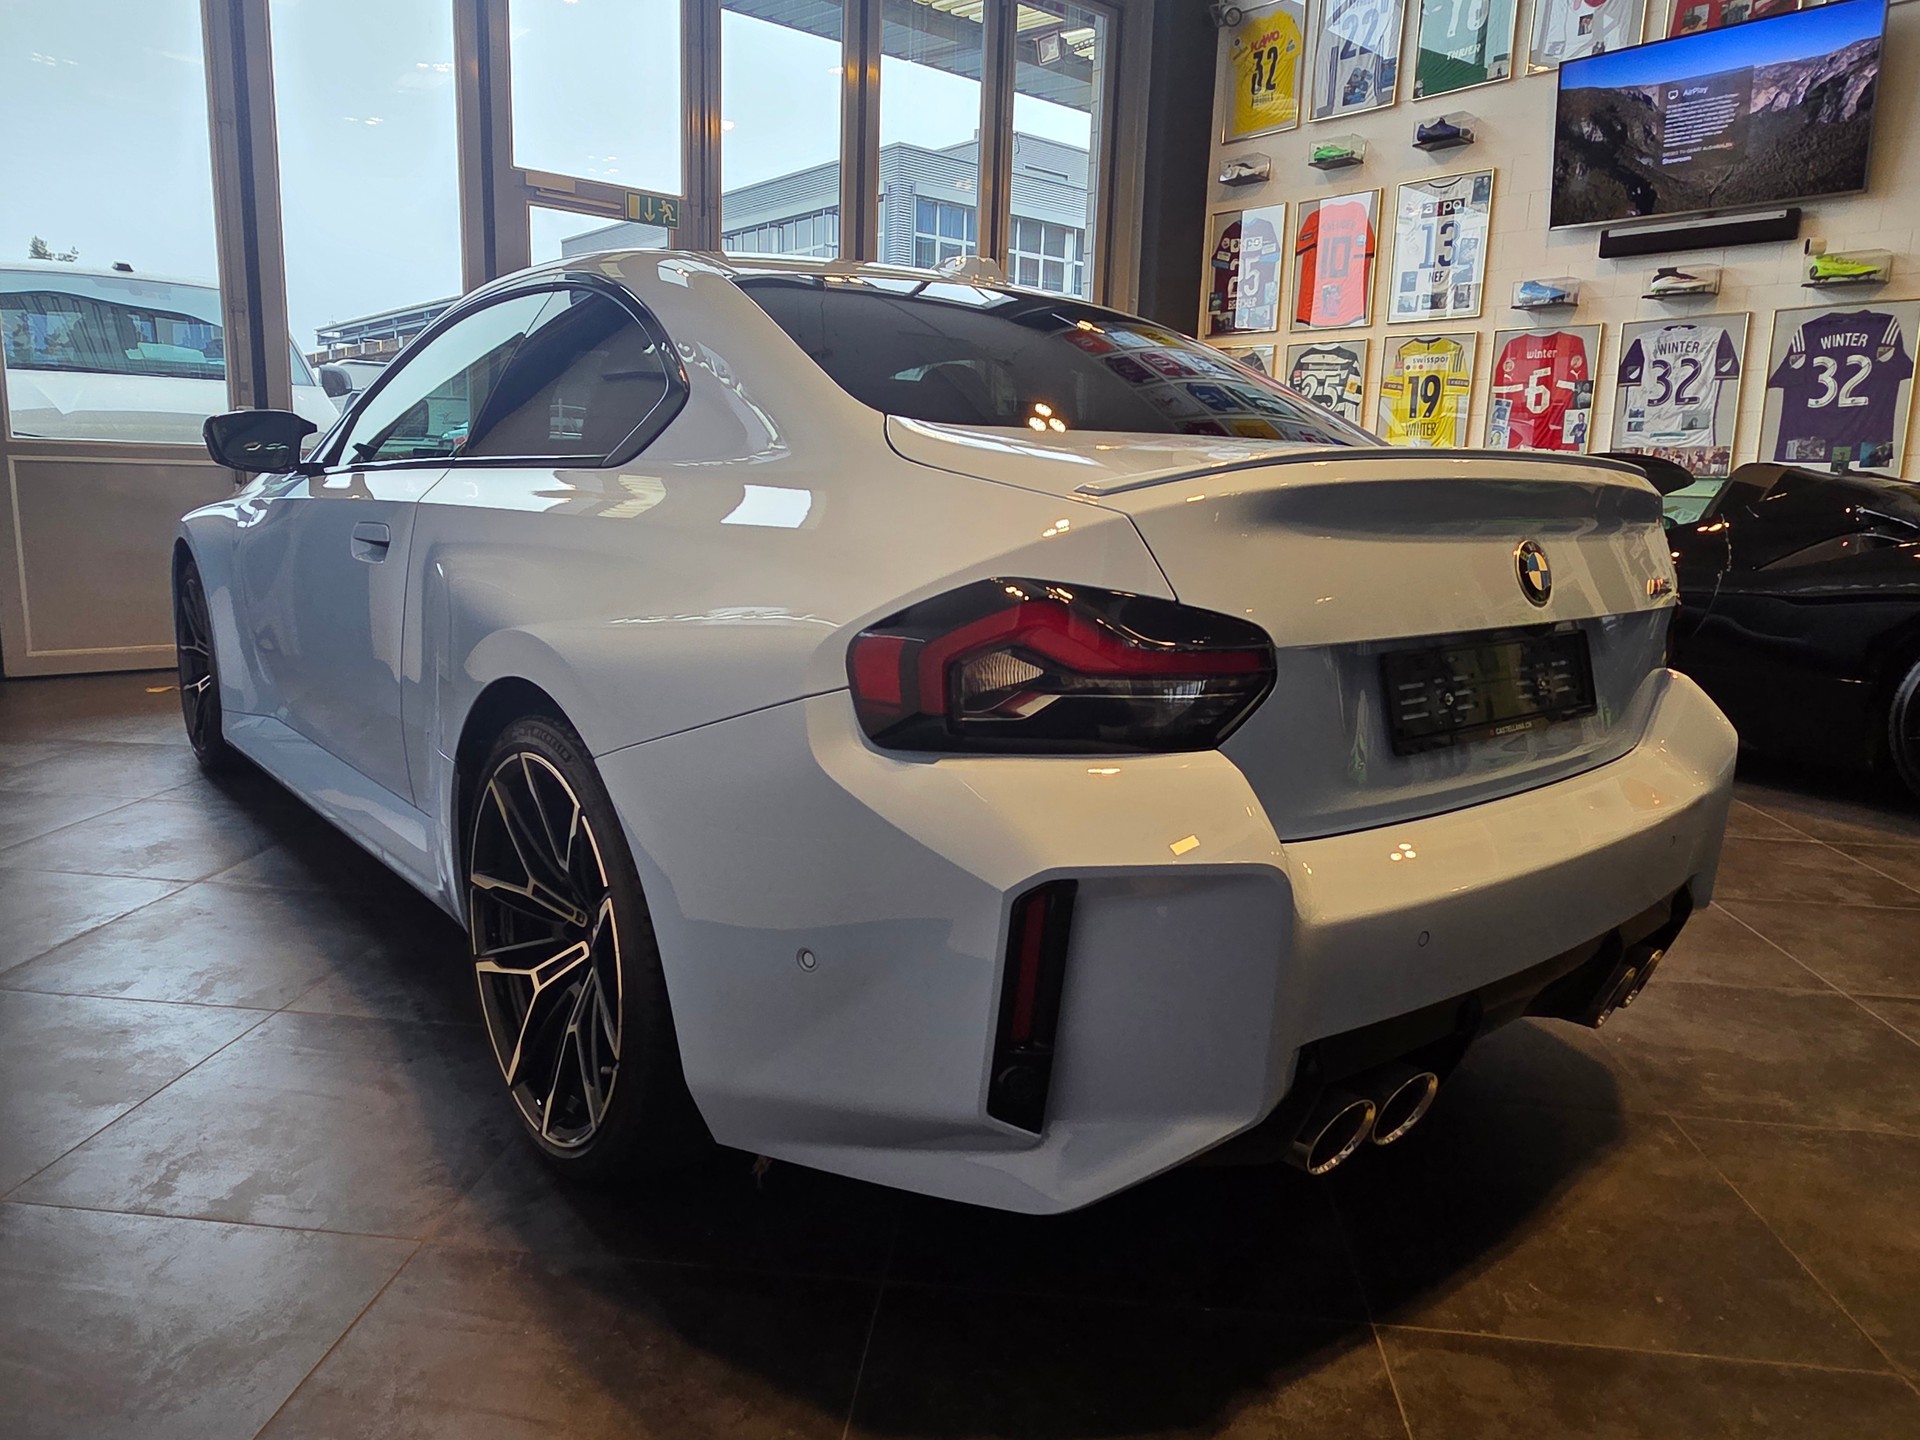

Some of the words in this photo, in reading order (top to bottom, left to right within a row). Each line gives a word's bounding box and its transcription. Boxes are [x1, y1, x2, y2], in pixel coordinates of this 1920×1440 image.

[1340, 8, 1379, 60] 22
[1251, 46, 1278, 95] 32
[1683, 87, 1708, 97] AirPlay
[1425, 199, 1463, 215] apo
[1321, 235, 1352, 280] 10
[1419, 220, 1461, 269] 13
[1227, 255, 1261, 299] 25
[1428, 271, 1444, 283] NEF
[1526, 348, 1558, 359] winter
[1658, 341, 1700, 355] WINTER
[1820, 333, 1868, 349] WINTER
[1301, 374, 1341, 412] 25
[1408, 375, 1441, 418] 19
[1525, 367, 1551, 414] 6
[1647, 358, 1702, 407] 32
[1807, 355, 1872, 408] 32
[1405, 422, 1437, 437] WINTER
